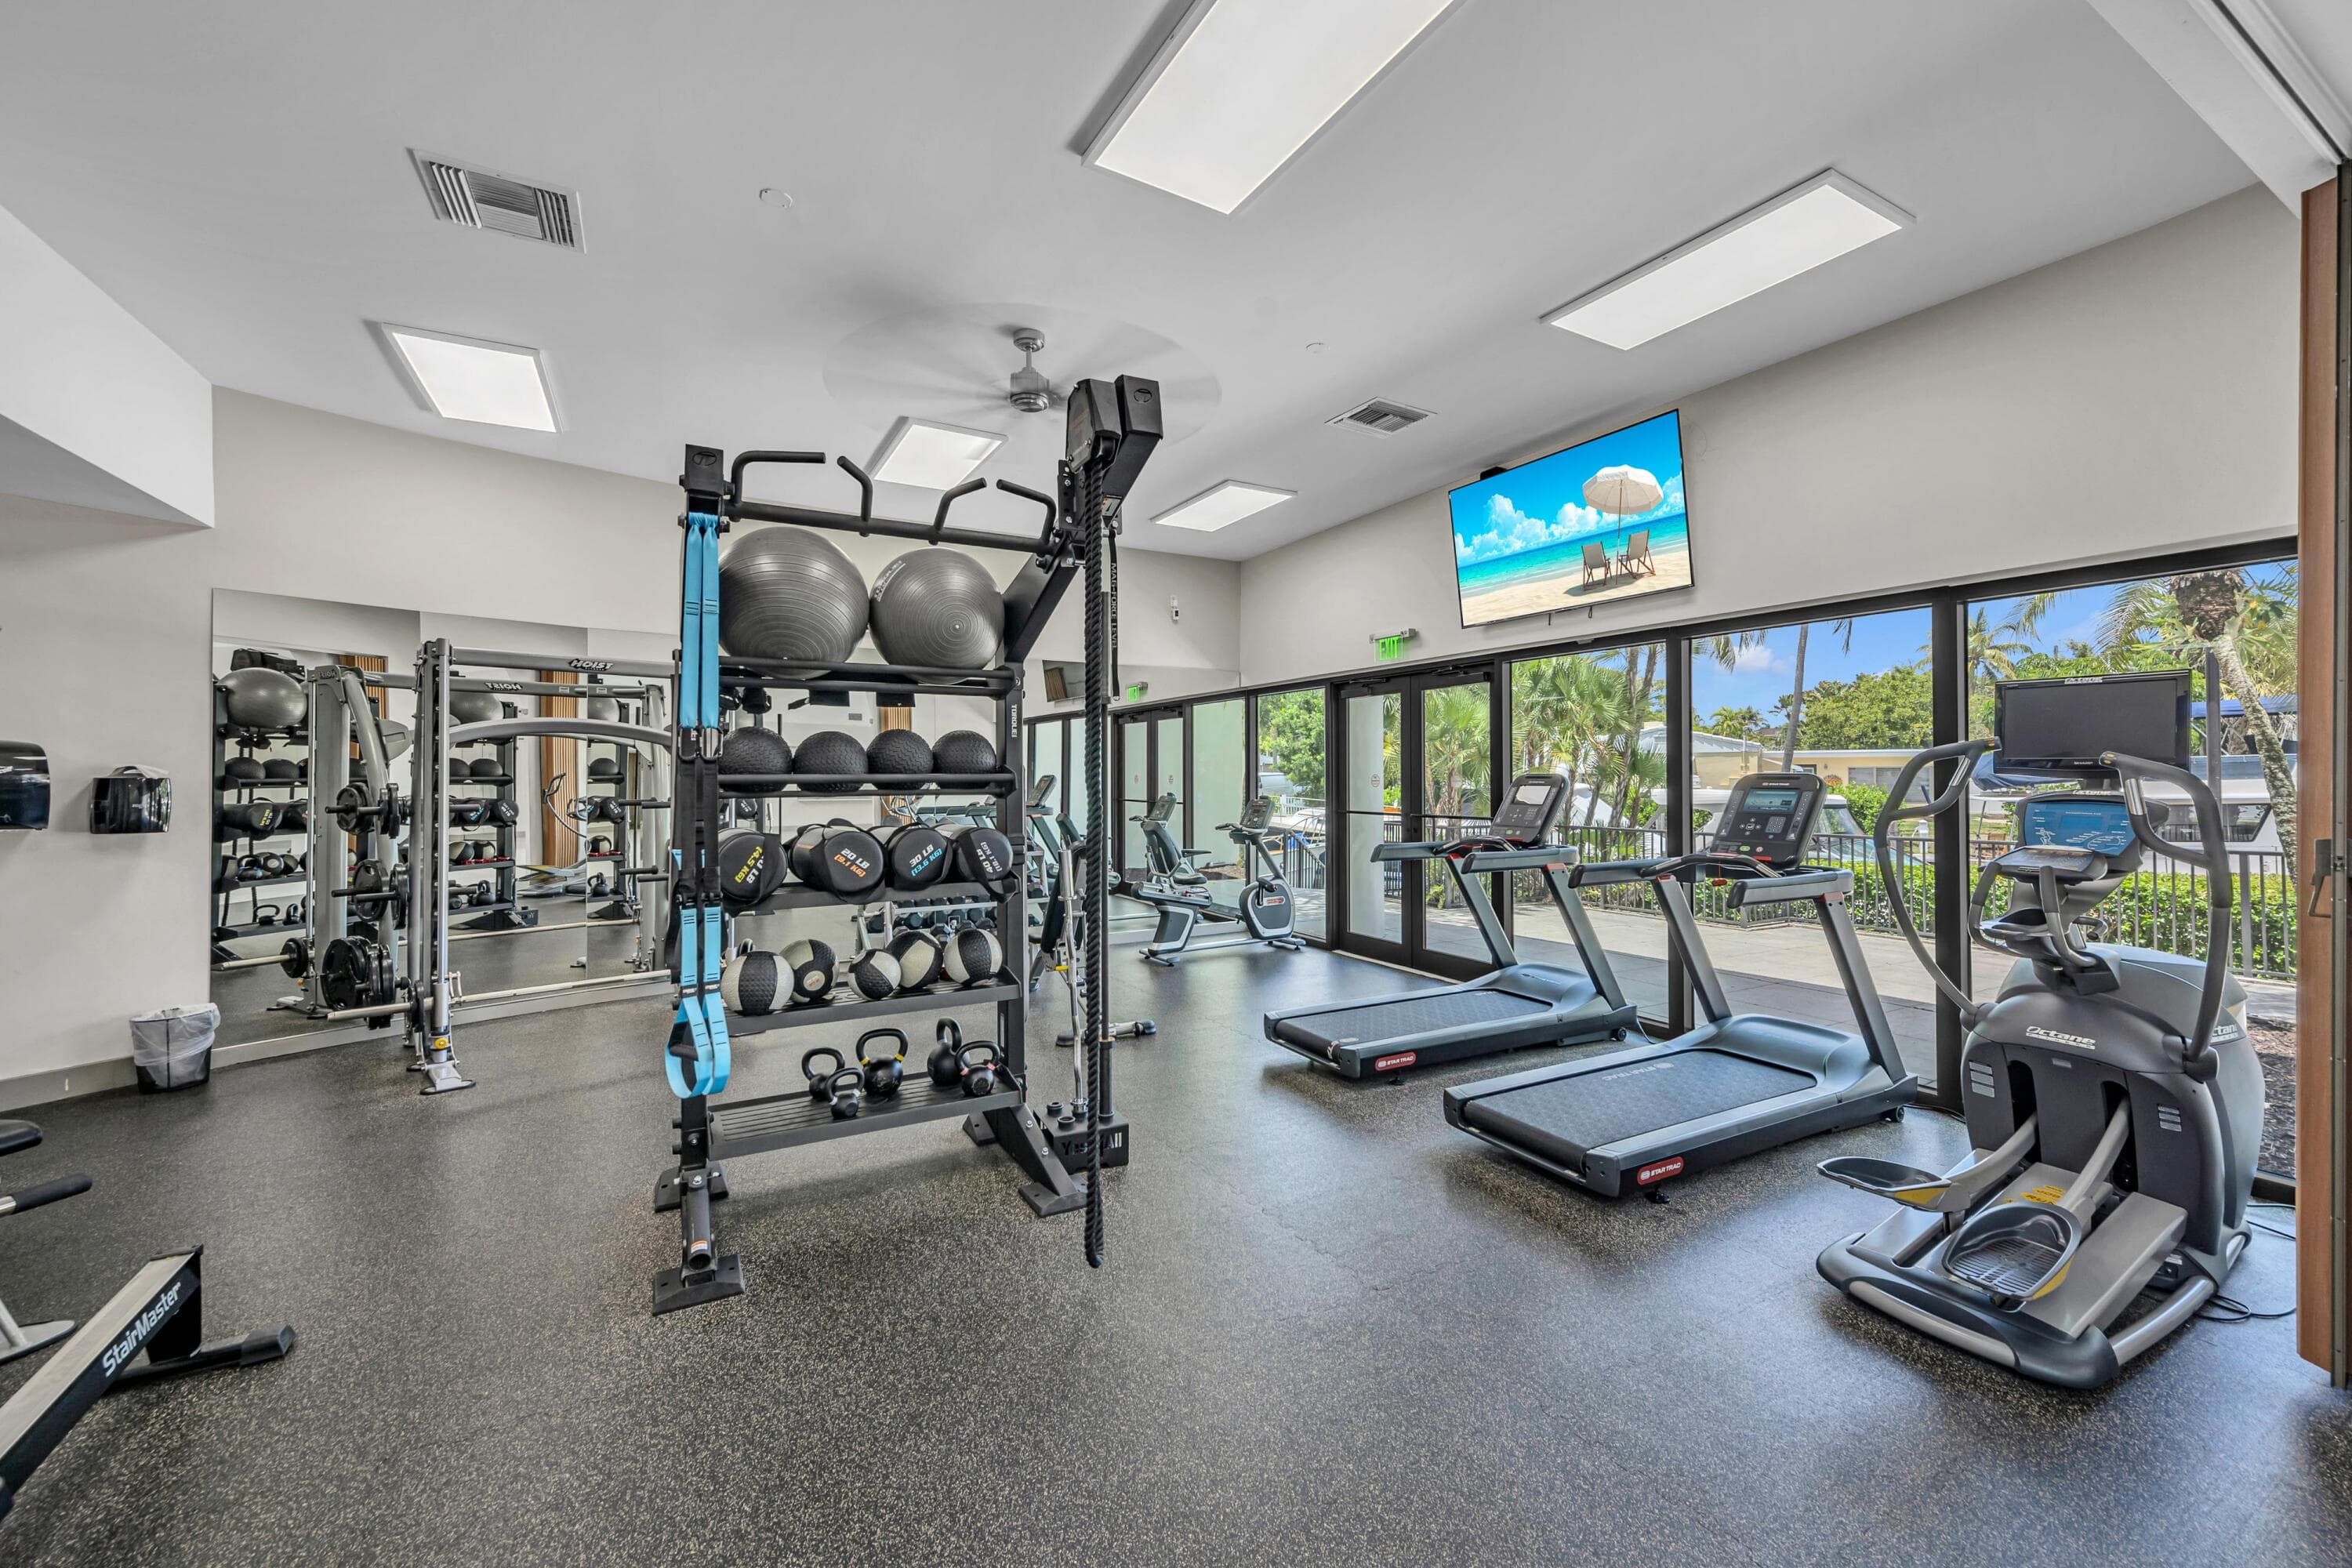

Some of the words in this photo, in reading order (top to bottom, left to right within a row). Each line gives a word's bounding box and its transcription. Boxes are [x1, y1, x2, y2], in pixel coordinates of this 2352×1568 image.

[1379, 637, 1399, 660] EXIT
[570, 659, 615, 670] HOIST
[909, 853, 923, 868] 30
[921, 844, 935, 857] LB
[980, 841, 992, 855] KG)
[833, 853, 852, 867] (9.1
[849, 864, 867, 877] KG)
[840, 848, 857, 860] 20
[855, 858, 871, 869] LB
[910, 858, 930, 877] (13.6
[928, 848, 942, 862] KG)
[982, 860, 994, 874] 40
[734, 864, 750, 884] KG)
[746, 868, 759, 884] LB
[2026, 1025, 2096, 1045] Octane
[1650, 1167, 1666, 1177] STAR
[1666, 1162, 1682, 1172] TRAC
[102, 1282, 181, 1378] StairMaster
